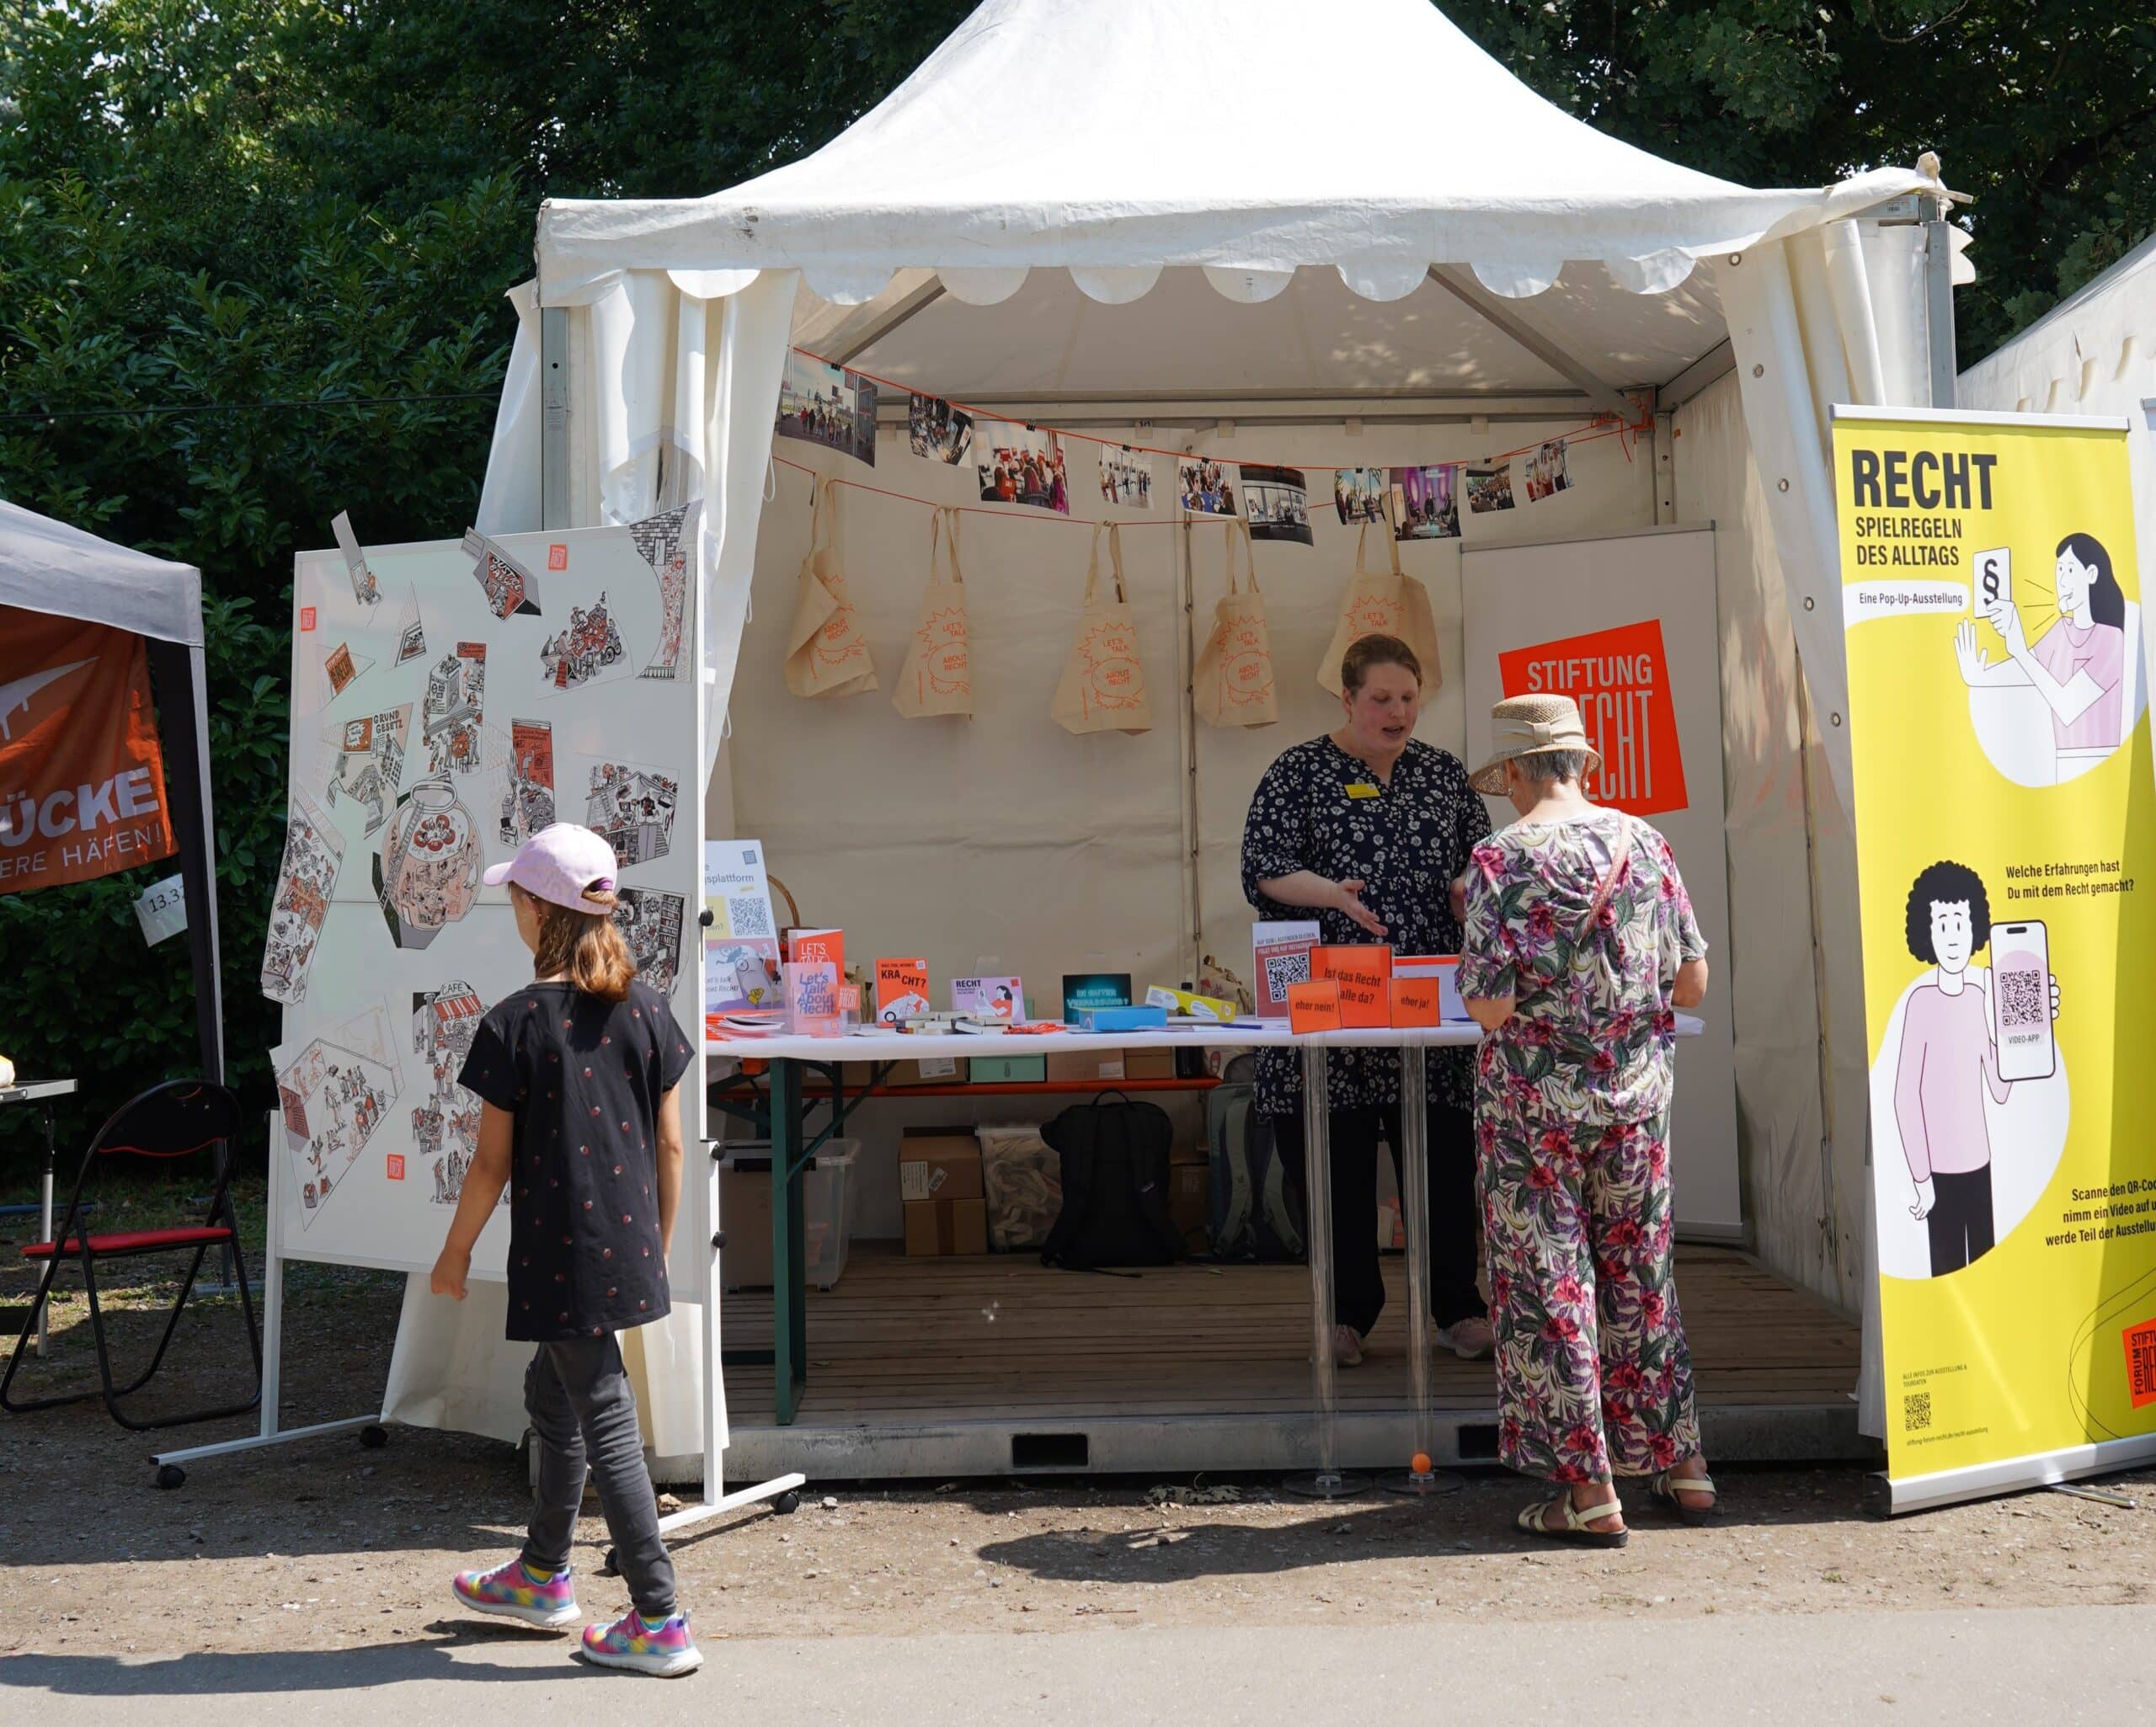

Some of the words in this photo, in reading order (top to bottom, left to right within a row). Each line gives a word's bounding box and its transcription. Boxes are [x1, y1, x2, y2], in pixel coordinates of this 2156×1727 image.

[1851, 449, 1997, 509] RECHT
[1855, 516, 1962, 539] SPIELREGELN
[1857, 545, 1887, 566] DES
[1892, 545, 1959, 567] ALLTAGS
[1860, 593, 1877, 605] Eine
[1879, 592, 1963, 607] Pop-Up-Ausstellung
[1527, 653, 1652, 691] STIFTUNG
[374, 710, 399, 724] GRUND
[376, 720, 403, 734] GESETZ
[1577, 690, 1653, 801] ECHT
[63, 823, 162, 867] HÄFEN!
[2006, 864, 2042, 879] Welche
[2045, 862, 2100, 878] Erfahrungen
[2100, 860, 2120, 873] hast
[2007, 887, 2020, 900] Du
[2022, 885, 2039, 899] mit
[2041, 884, 2063, 898] dem
[2065, 882, 2089, 897] Recht
[2090, 878, 2133, 897] gemacht?
[149, 886, 184, 913] 13.3
[801, 943, 826, 955] LET'S
[799, 973, 829, 984] Let's
[881, 970, 900, 979] KRA
[1324, 967, 1337, 979] Ist
[1338, 971, 1353, 983] das
[1355, 973, 1381, 988] Recht
[801, 982, 827, 994] Talk
[1340, 989, 1357, 1002] alle
[1358, 991, 1374, 1004] da?
[798, 993, 835, 1005] About
[799, 1002, 835, 1015] Recht
[1295, 999, 1313, 1011] eher
[1314, 1002, 1335, 1013] nein!
[1401, 996, 1417, 1005] eher
[1418, 998, 1430, 1010] ja!
[2008, 1034, 2040, 1044] VIDEO-APP
[2072, 1187, 2108, 1202] Scanne
[2110, 1183, 2126, 1197] den
[2063, 1210, 2091, 1223] nimm
[2094, 1207, 2108, 1219] ein
[2111, 1203, 2134, 1217] Video
[2136, 1199, 2149, 1213] auf
[2046, 1230, 2077, 1246] werde
[2079, 1228, 2095, 1242] Teil
[2099, 1227, 2114, 1239] der
[2116, 1219, 2156, 1237] Ausstellu
[2132, 1330, 2156, 1347] STIFT
[2132, 1348, 2144, 1395] FORUM
[2142, 1346, 2156, 1394] RE
